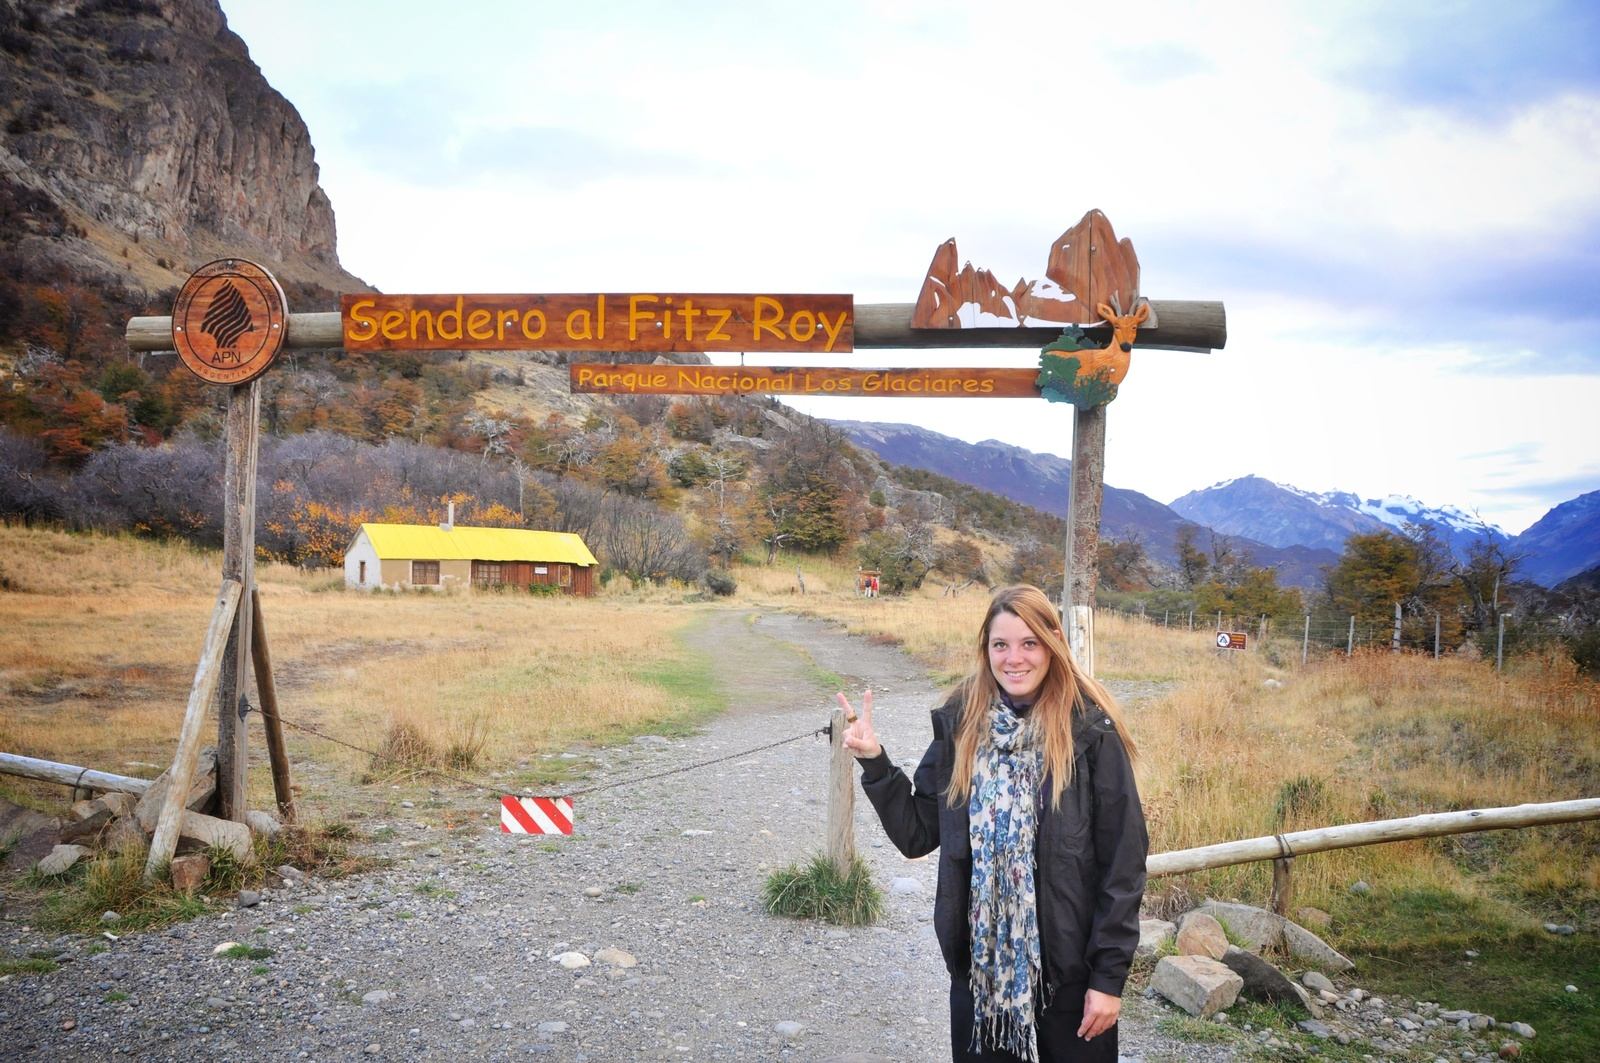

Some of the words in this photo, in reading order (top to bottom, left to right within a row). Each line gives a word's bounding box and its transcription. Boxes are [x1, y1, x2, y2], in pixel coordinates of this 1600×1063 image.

[349, 295, 547, 342] Sendero
[566, 294, 605, 341] al
[629, 295, 732, 342] Fitz
[753, 296, 847, 352] Roy
[211, 351, 241, 363] APN
[578, 368, 668, 392] Parque
[677, 370, 794, 392] Nacional
[805, 374, 851, 392] Los
[862, 373, 995, 393] Glaciares
